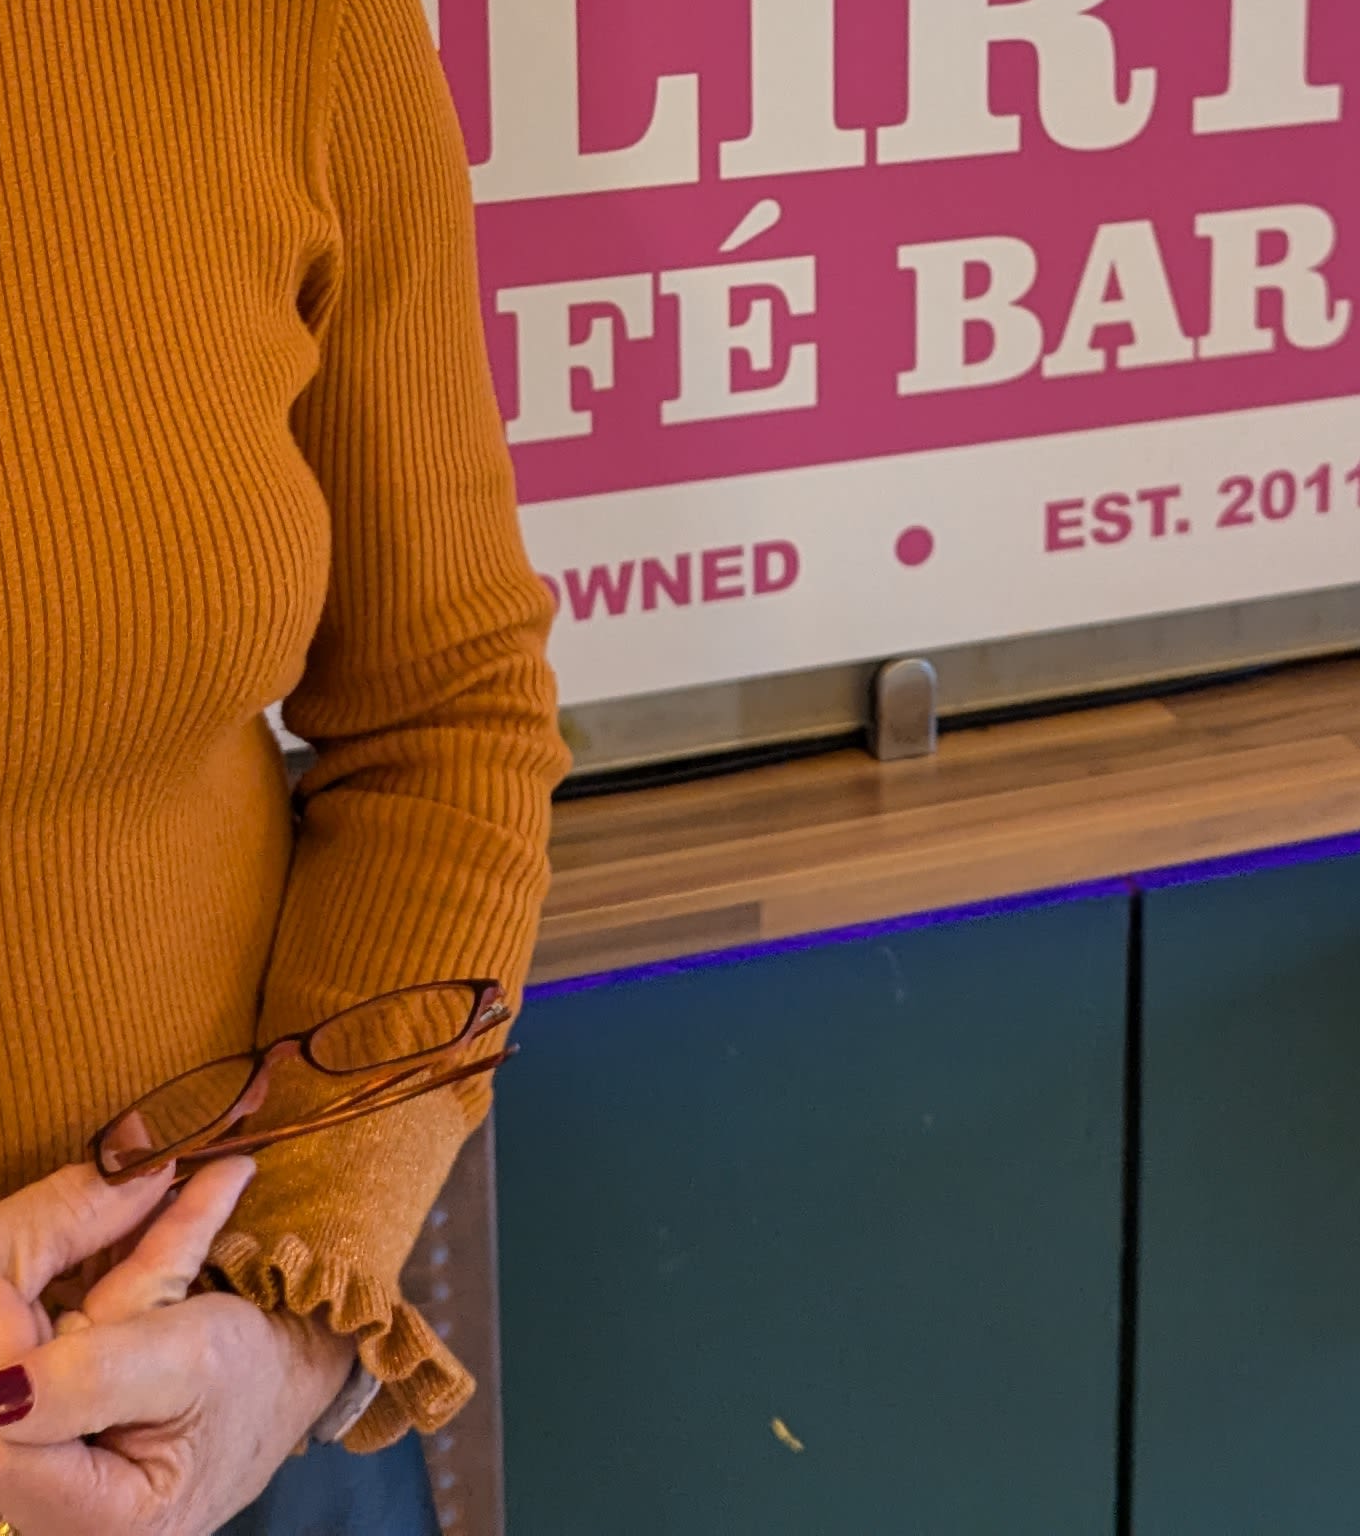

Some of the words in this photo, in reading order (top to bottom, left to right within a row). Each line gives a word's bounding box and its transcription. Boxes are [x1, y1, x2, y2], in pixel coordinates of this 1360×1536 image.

[898, 204, 1351, 396] BAR
[536, 539, 800, 622] WNED
[1044, 486, 1191, 553] EST.
